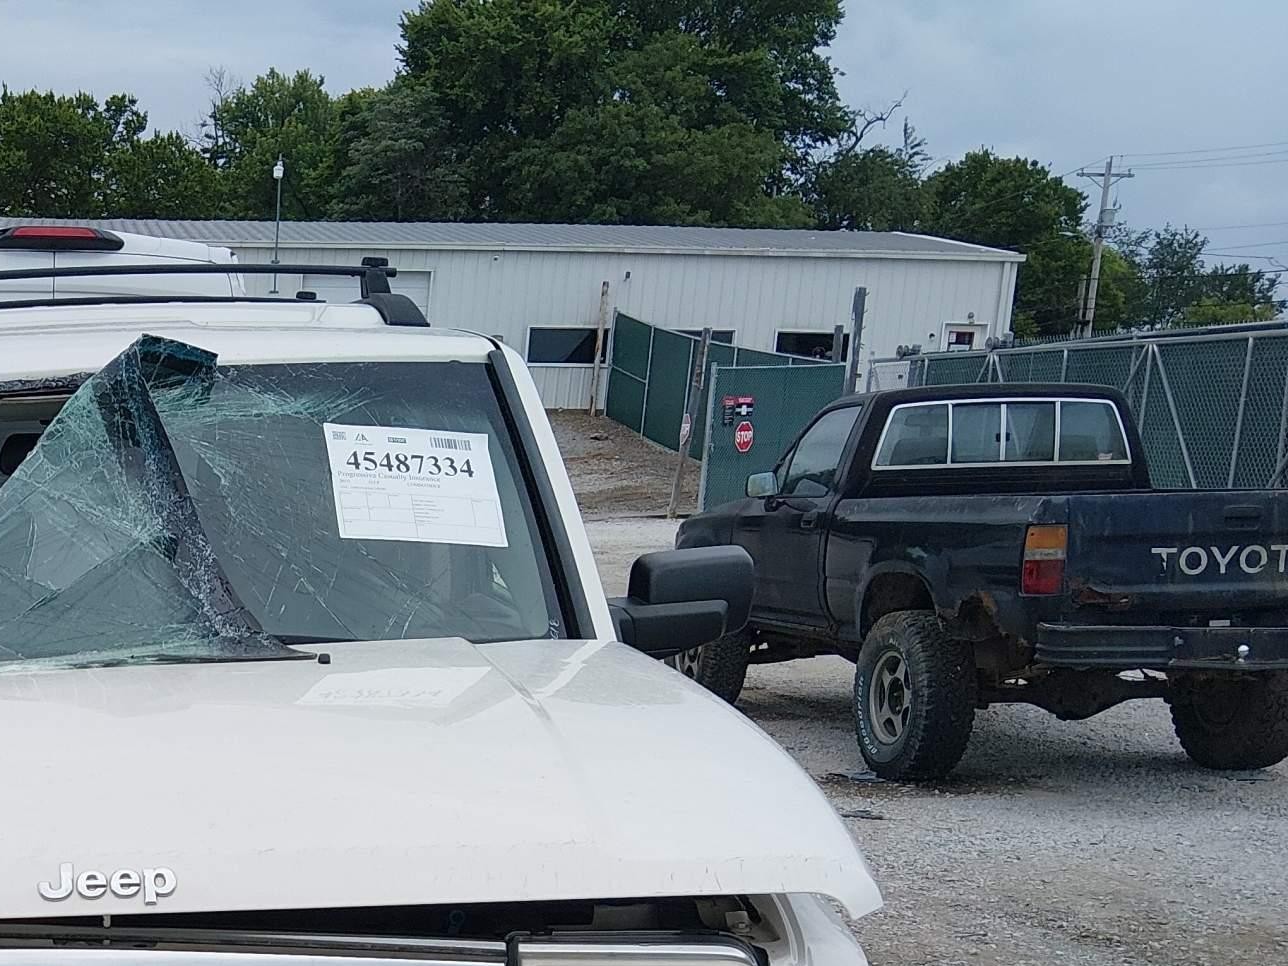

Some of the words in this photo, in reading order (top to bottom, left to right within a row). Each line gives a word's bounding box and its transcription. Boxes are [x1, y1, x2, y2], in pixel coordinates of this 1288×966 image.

[736, 430, 753, 444] STOP
[346, 450, 475, 478] 45487334
[37, 861, 178, 906] Jeep
